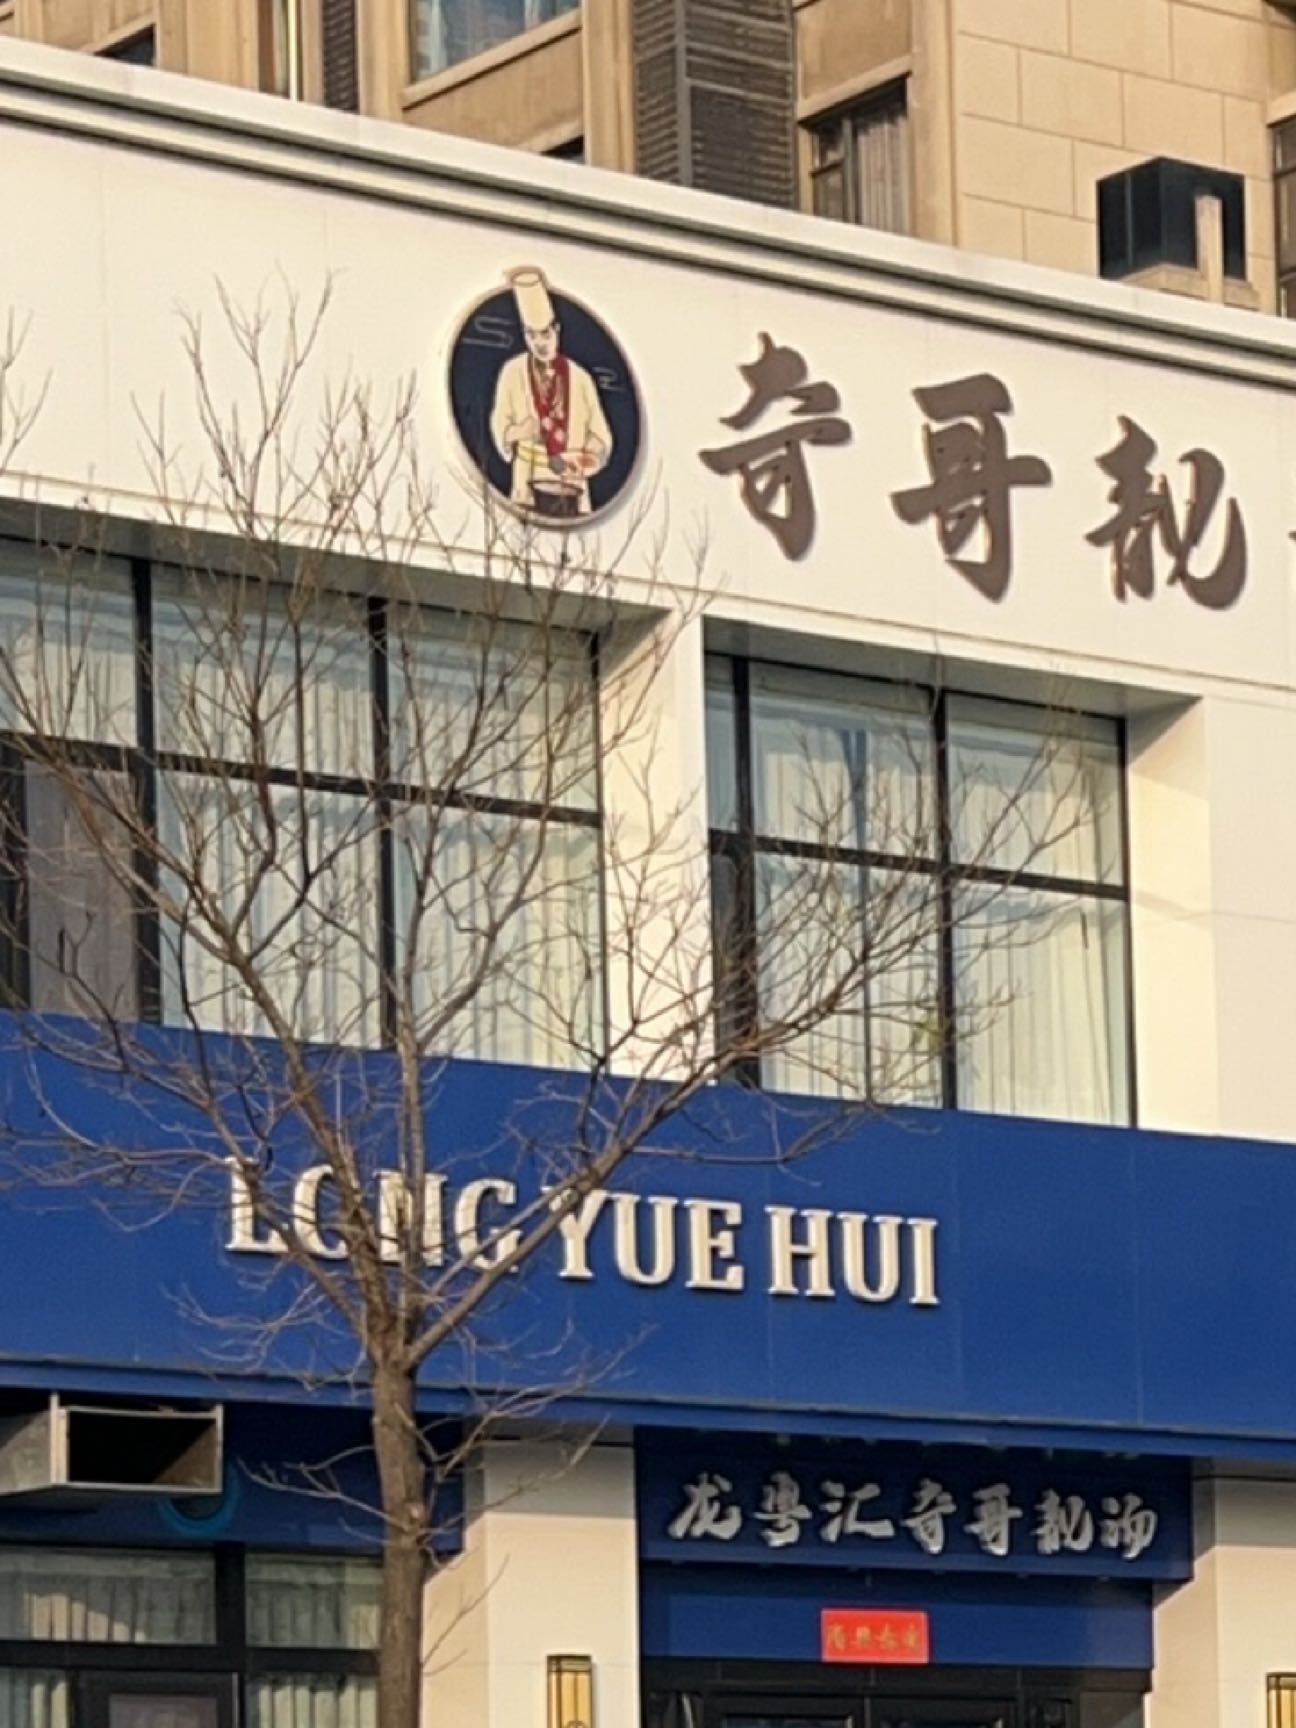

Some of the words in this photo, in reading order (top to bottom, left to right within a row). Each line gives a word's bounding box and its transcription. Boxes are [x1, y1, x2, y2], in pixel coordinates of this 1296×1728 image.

[543, 1183, 745, 1292] YUE
[766, 1204, 940, 1307] HUI
[667, 1470, 1160, 1561] 龙粤汇奇哥靓汤
